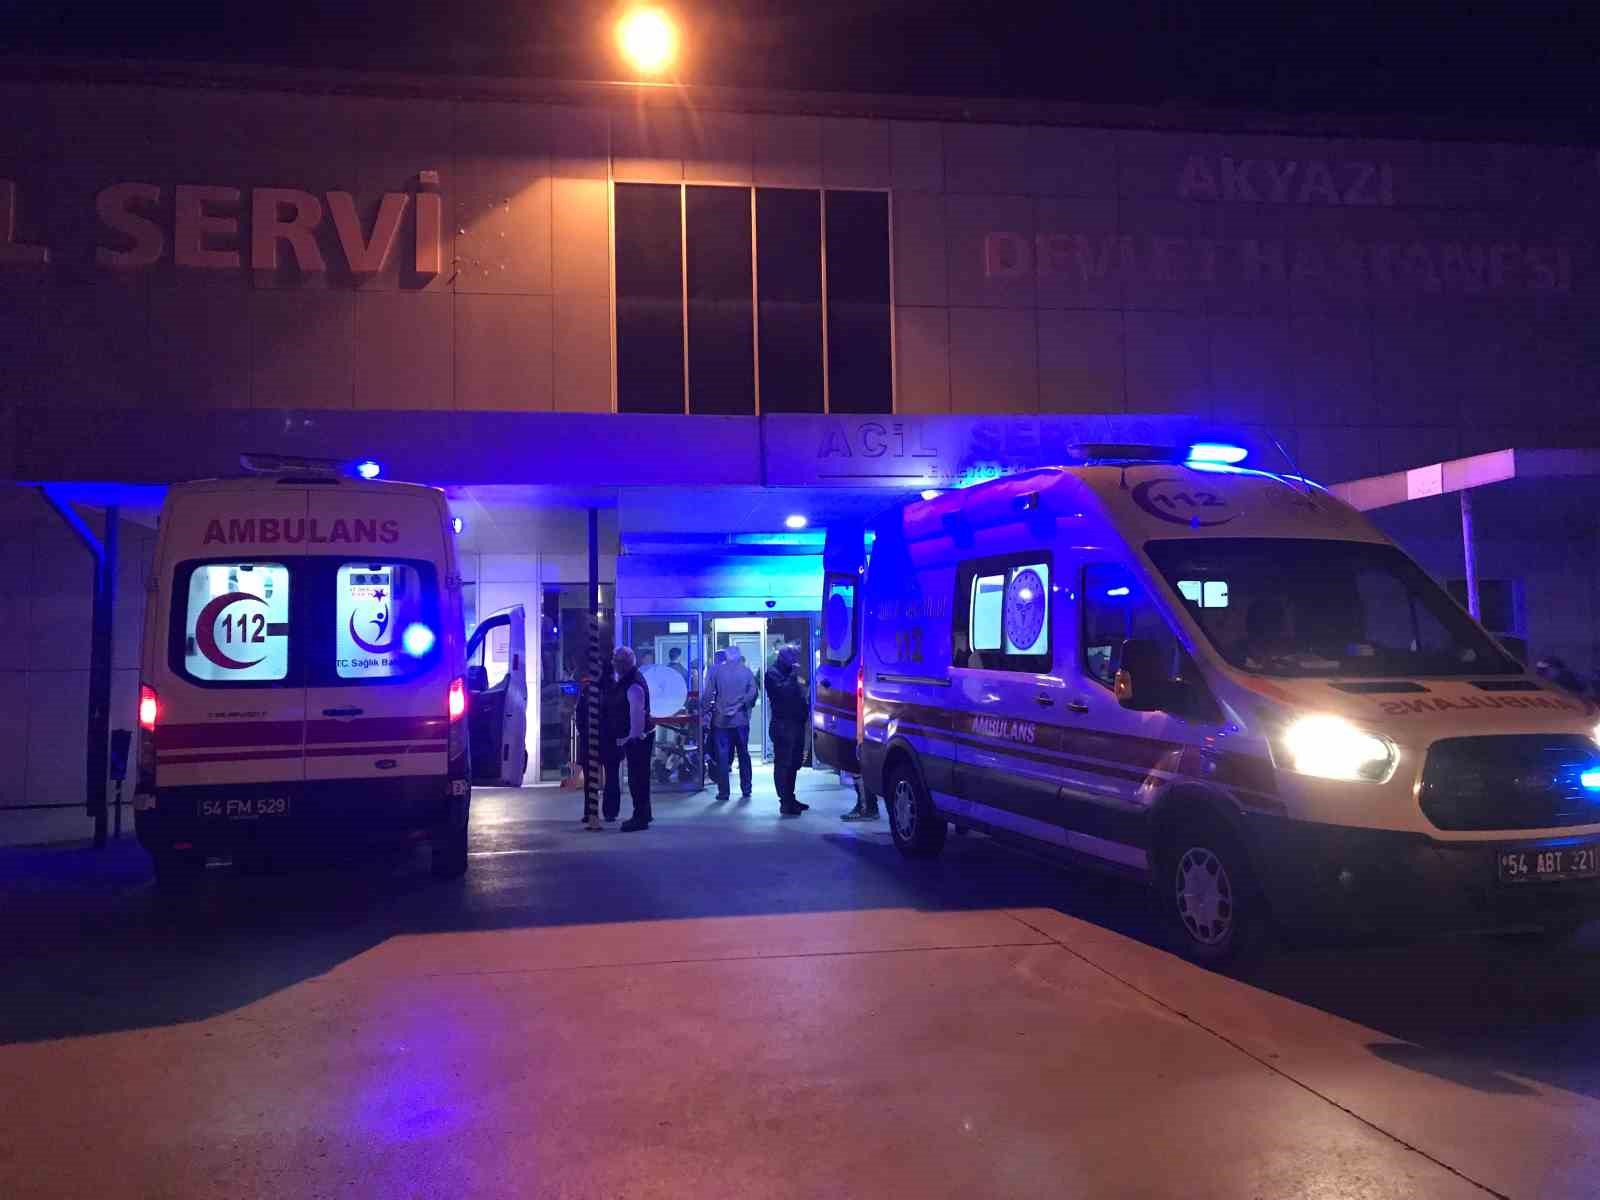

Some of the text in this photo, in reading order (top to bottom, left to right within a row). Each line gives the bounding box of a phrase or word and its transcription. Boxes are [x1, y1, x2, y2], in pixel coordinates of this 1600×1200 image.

[1153, 491, 1226, 509] 112
[202, 518, 400, 545] AMBULANS
[222, 613, 265, 644] 112
[971, 717, 1036, 743] AMBULANS
[203, 800, 222, 816] 54
[226, 799, 252, 815] FM
[1508, 854, 1529, 874] 54
[1536, 852, 1563, 872] ABT
